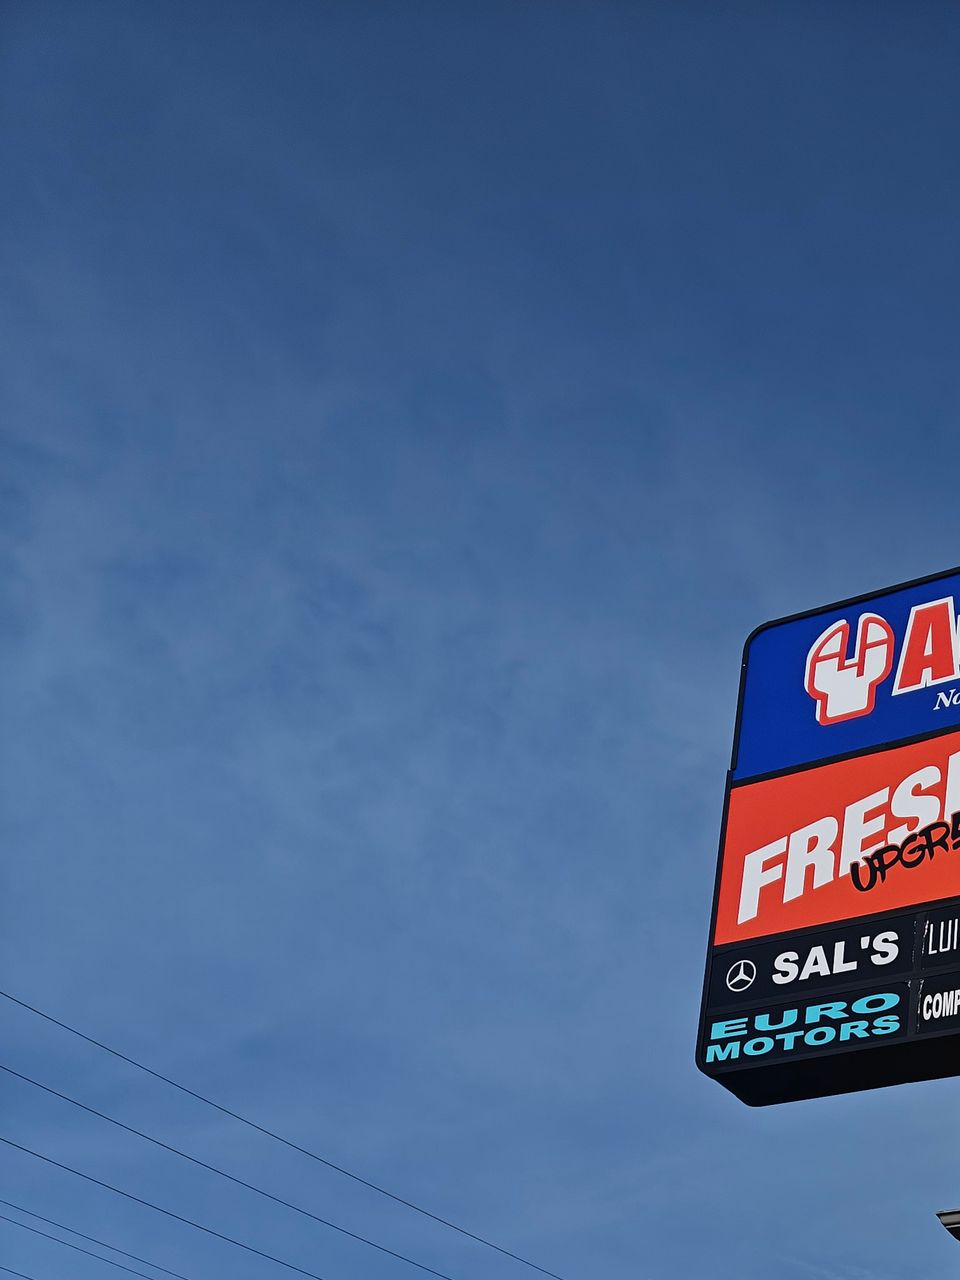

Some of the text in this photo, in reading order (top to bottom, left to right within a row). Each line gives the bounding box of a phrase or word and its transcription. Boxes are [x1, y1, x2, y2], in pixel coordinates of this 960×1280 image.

[771, 930, 899, 985] SAL'S
[705, 1015, 900, 1063] MOTORS
[710, 993, 900, 1040] EURO
